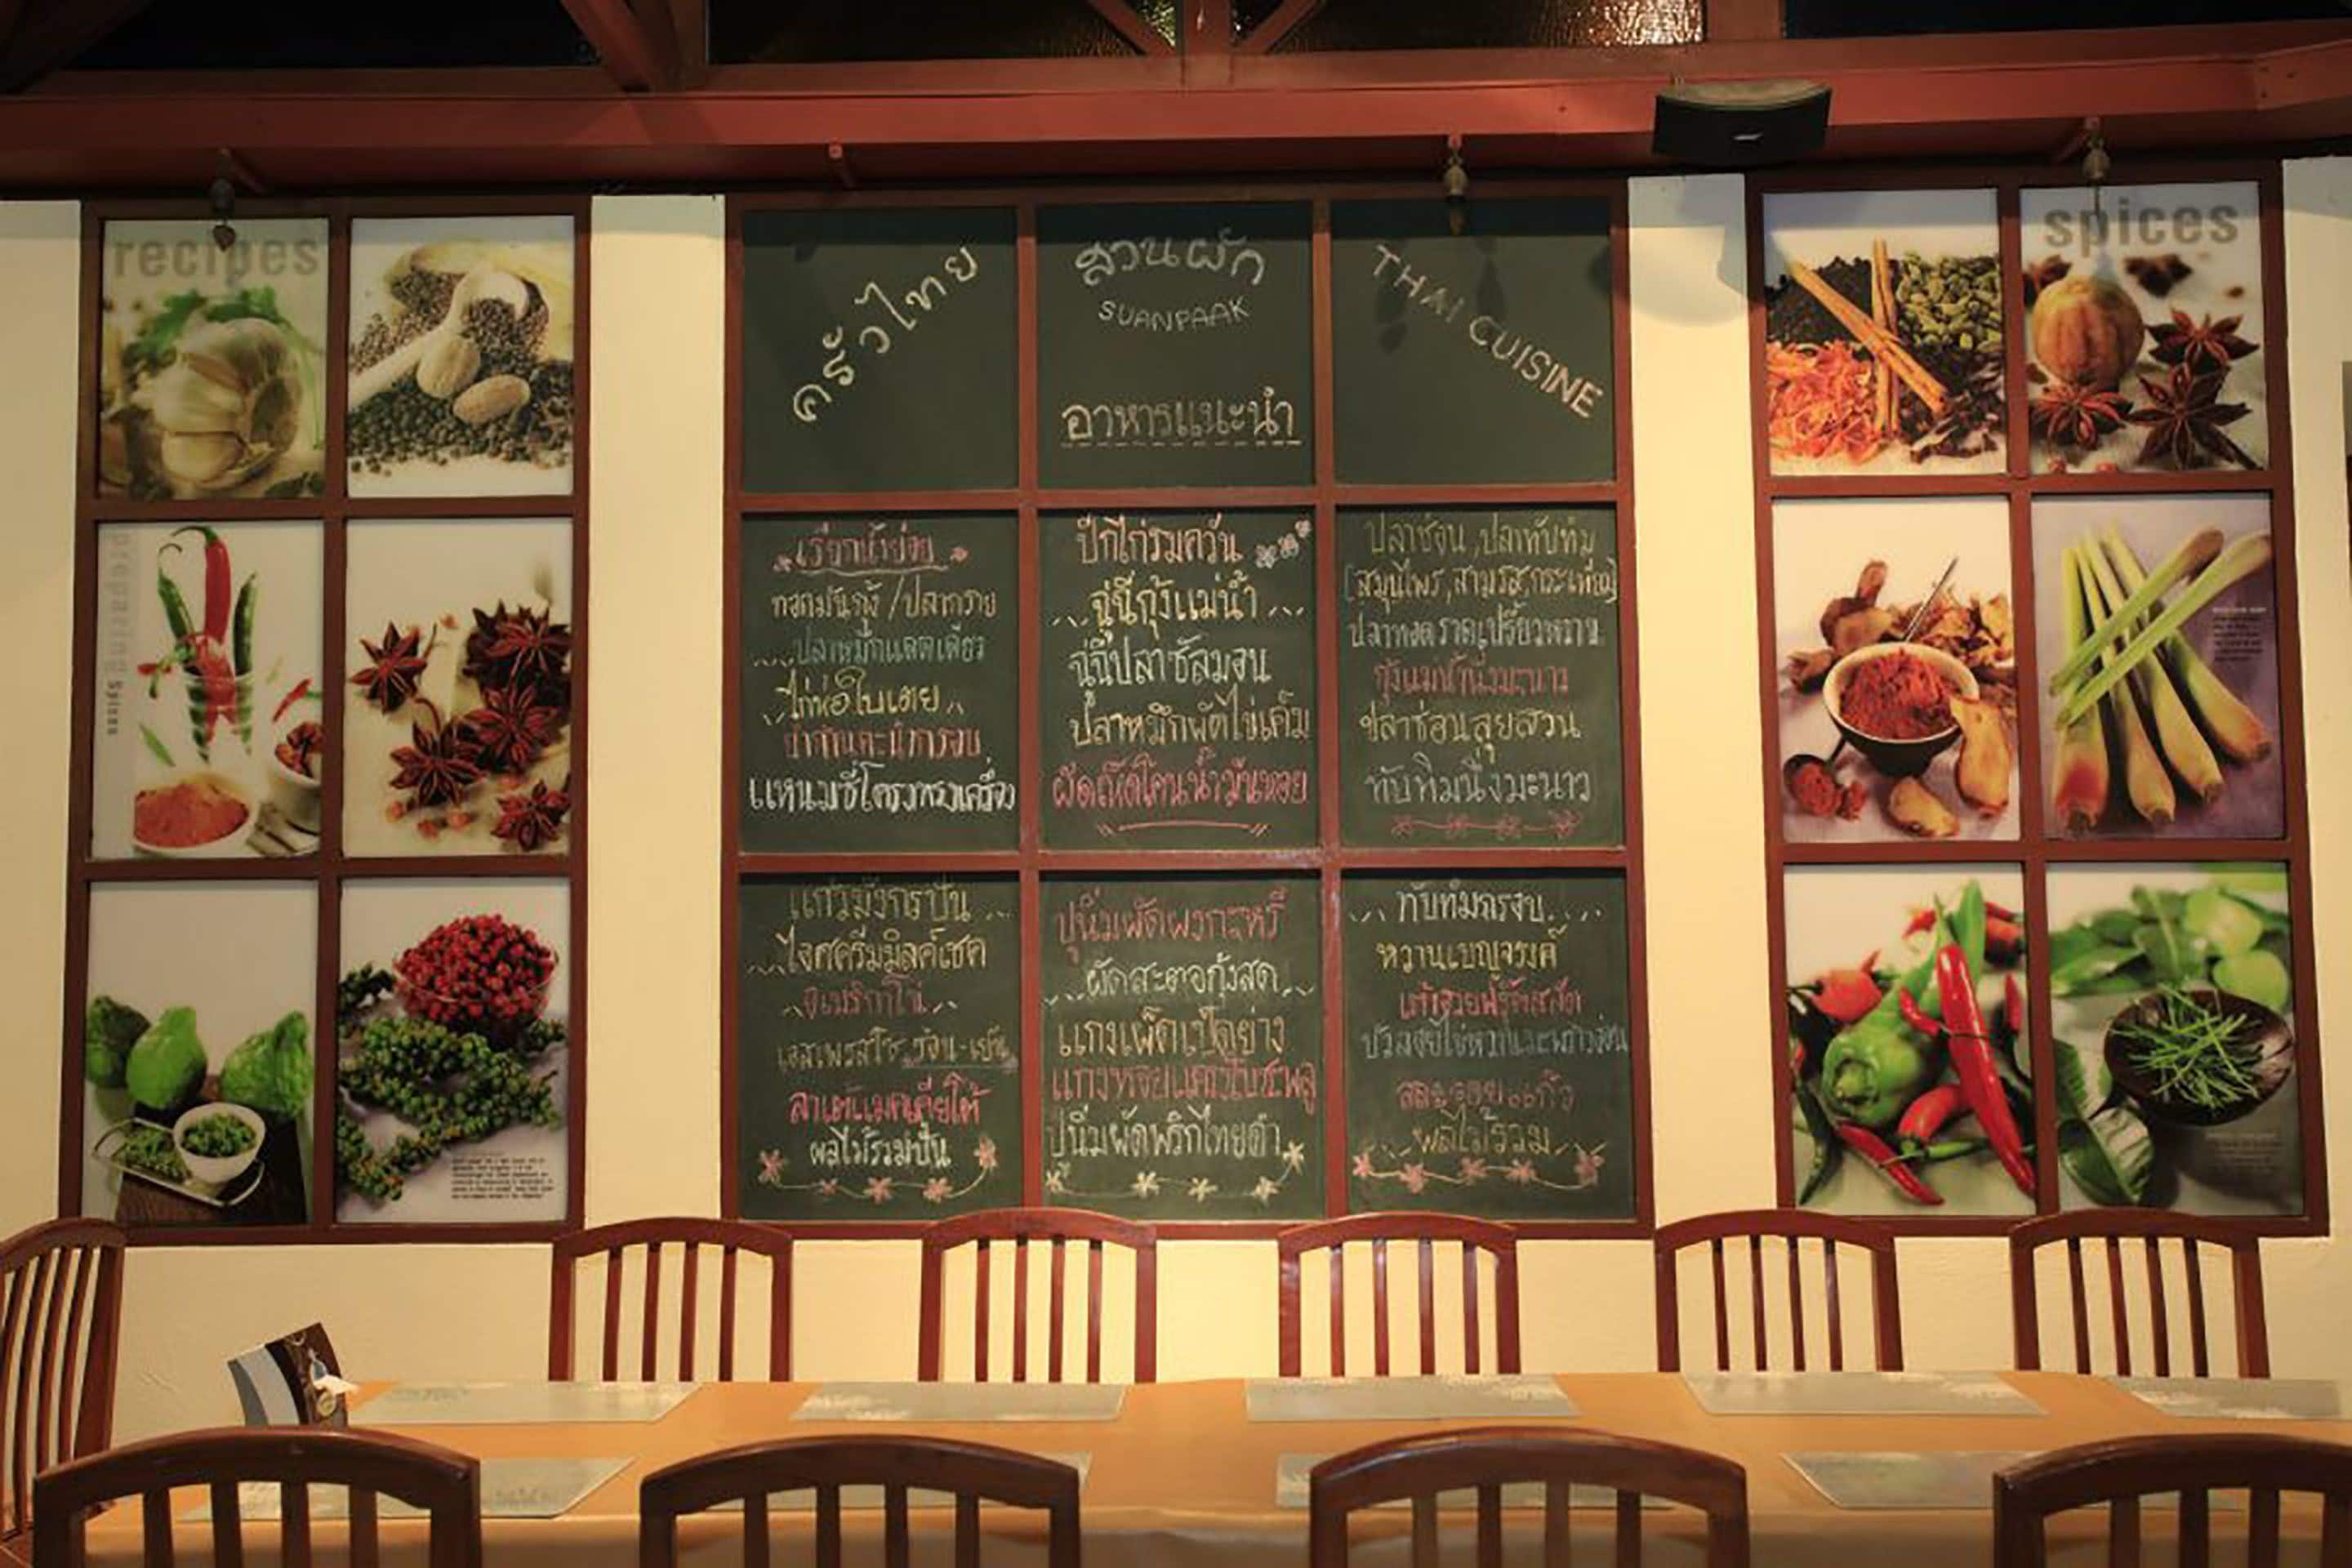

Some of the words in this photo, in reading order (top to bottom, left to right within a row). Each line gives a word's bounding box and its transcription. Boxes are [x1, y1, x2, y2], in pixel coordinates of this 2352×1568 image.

[2043, 196, 2239, 258] spices
[1075, 228, 1267, 287] สวนผัก
[791, 245, 981, 423] ครัวไทย
[1097, 298, 1250, 332] SUANPAAK
[1372, 244, 1465, 323] THAI
[1468, 315, 1603, 419] CUISINE
[1062, 388, 1296, 441] อาหารแนะนำ
[1077, 514, 1243, 565] ปีกไก่รมควัน
[1359, 700, 1581, 761] ปลาช่อนลุยสวน
